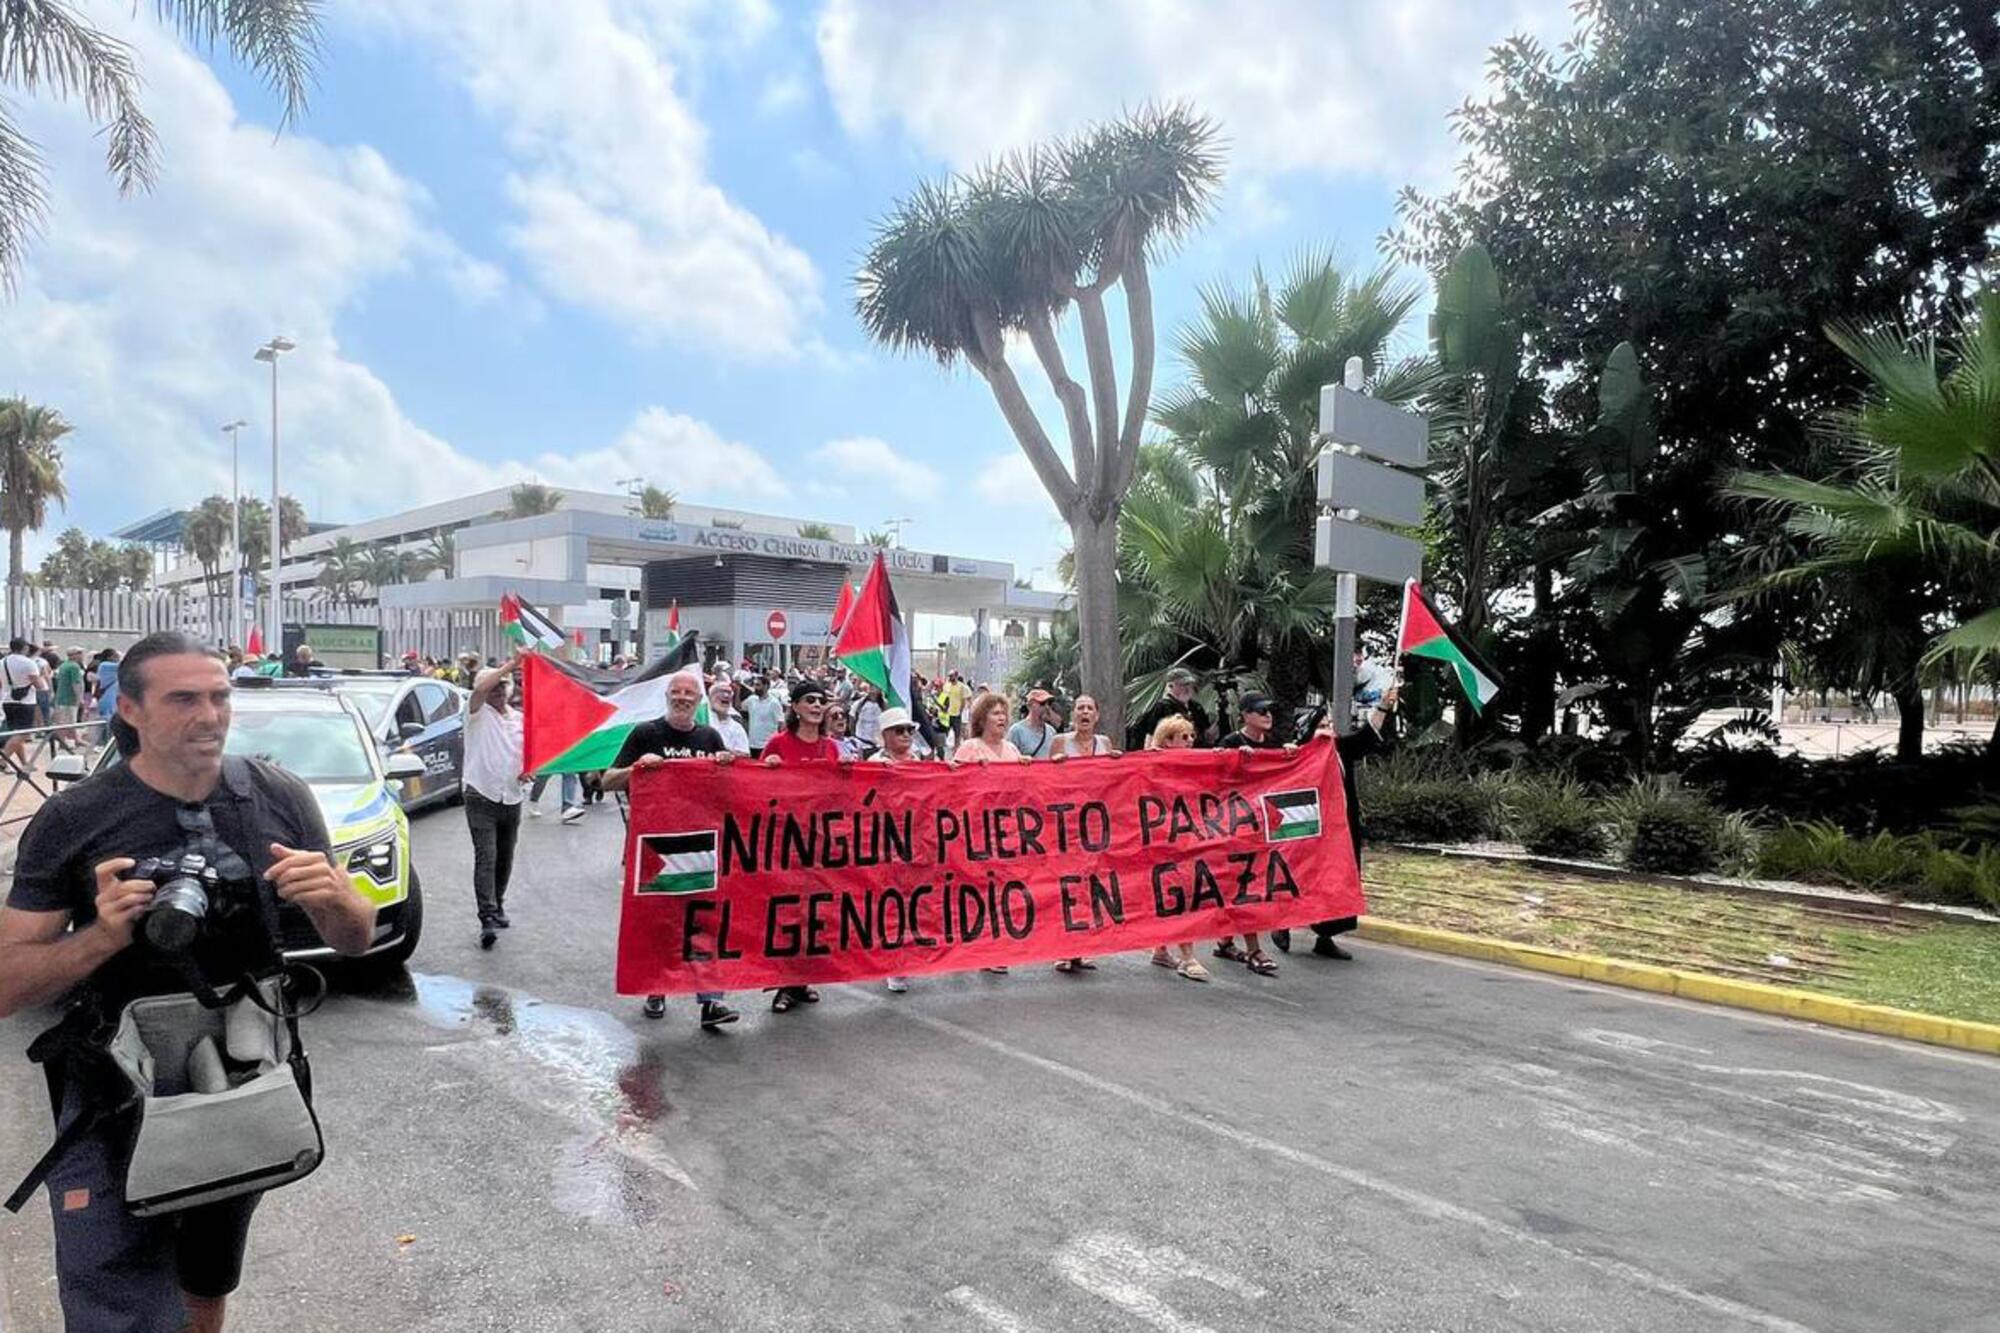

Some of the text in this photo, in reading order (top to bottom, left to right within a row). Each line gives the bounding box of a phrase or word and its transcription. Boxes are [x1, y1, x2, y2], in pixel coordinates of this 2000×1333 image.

[694, 530, 759, 552] ACCESO
[763, 538, 823, 558] CENTRAL
[936, 801, 1110, 864] PUERTO
[1138, 791, 1260, 845] PARA
[683, 899, 741, 962] EL
[1060, 871, 1125, 932] EN
[1152, 850, 1300, 917] GAZA
